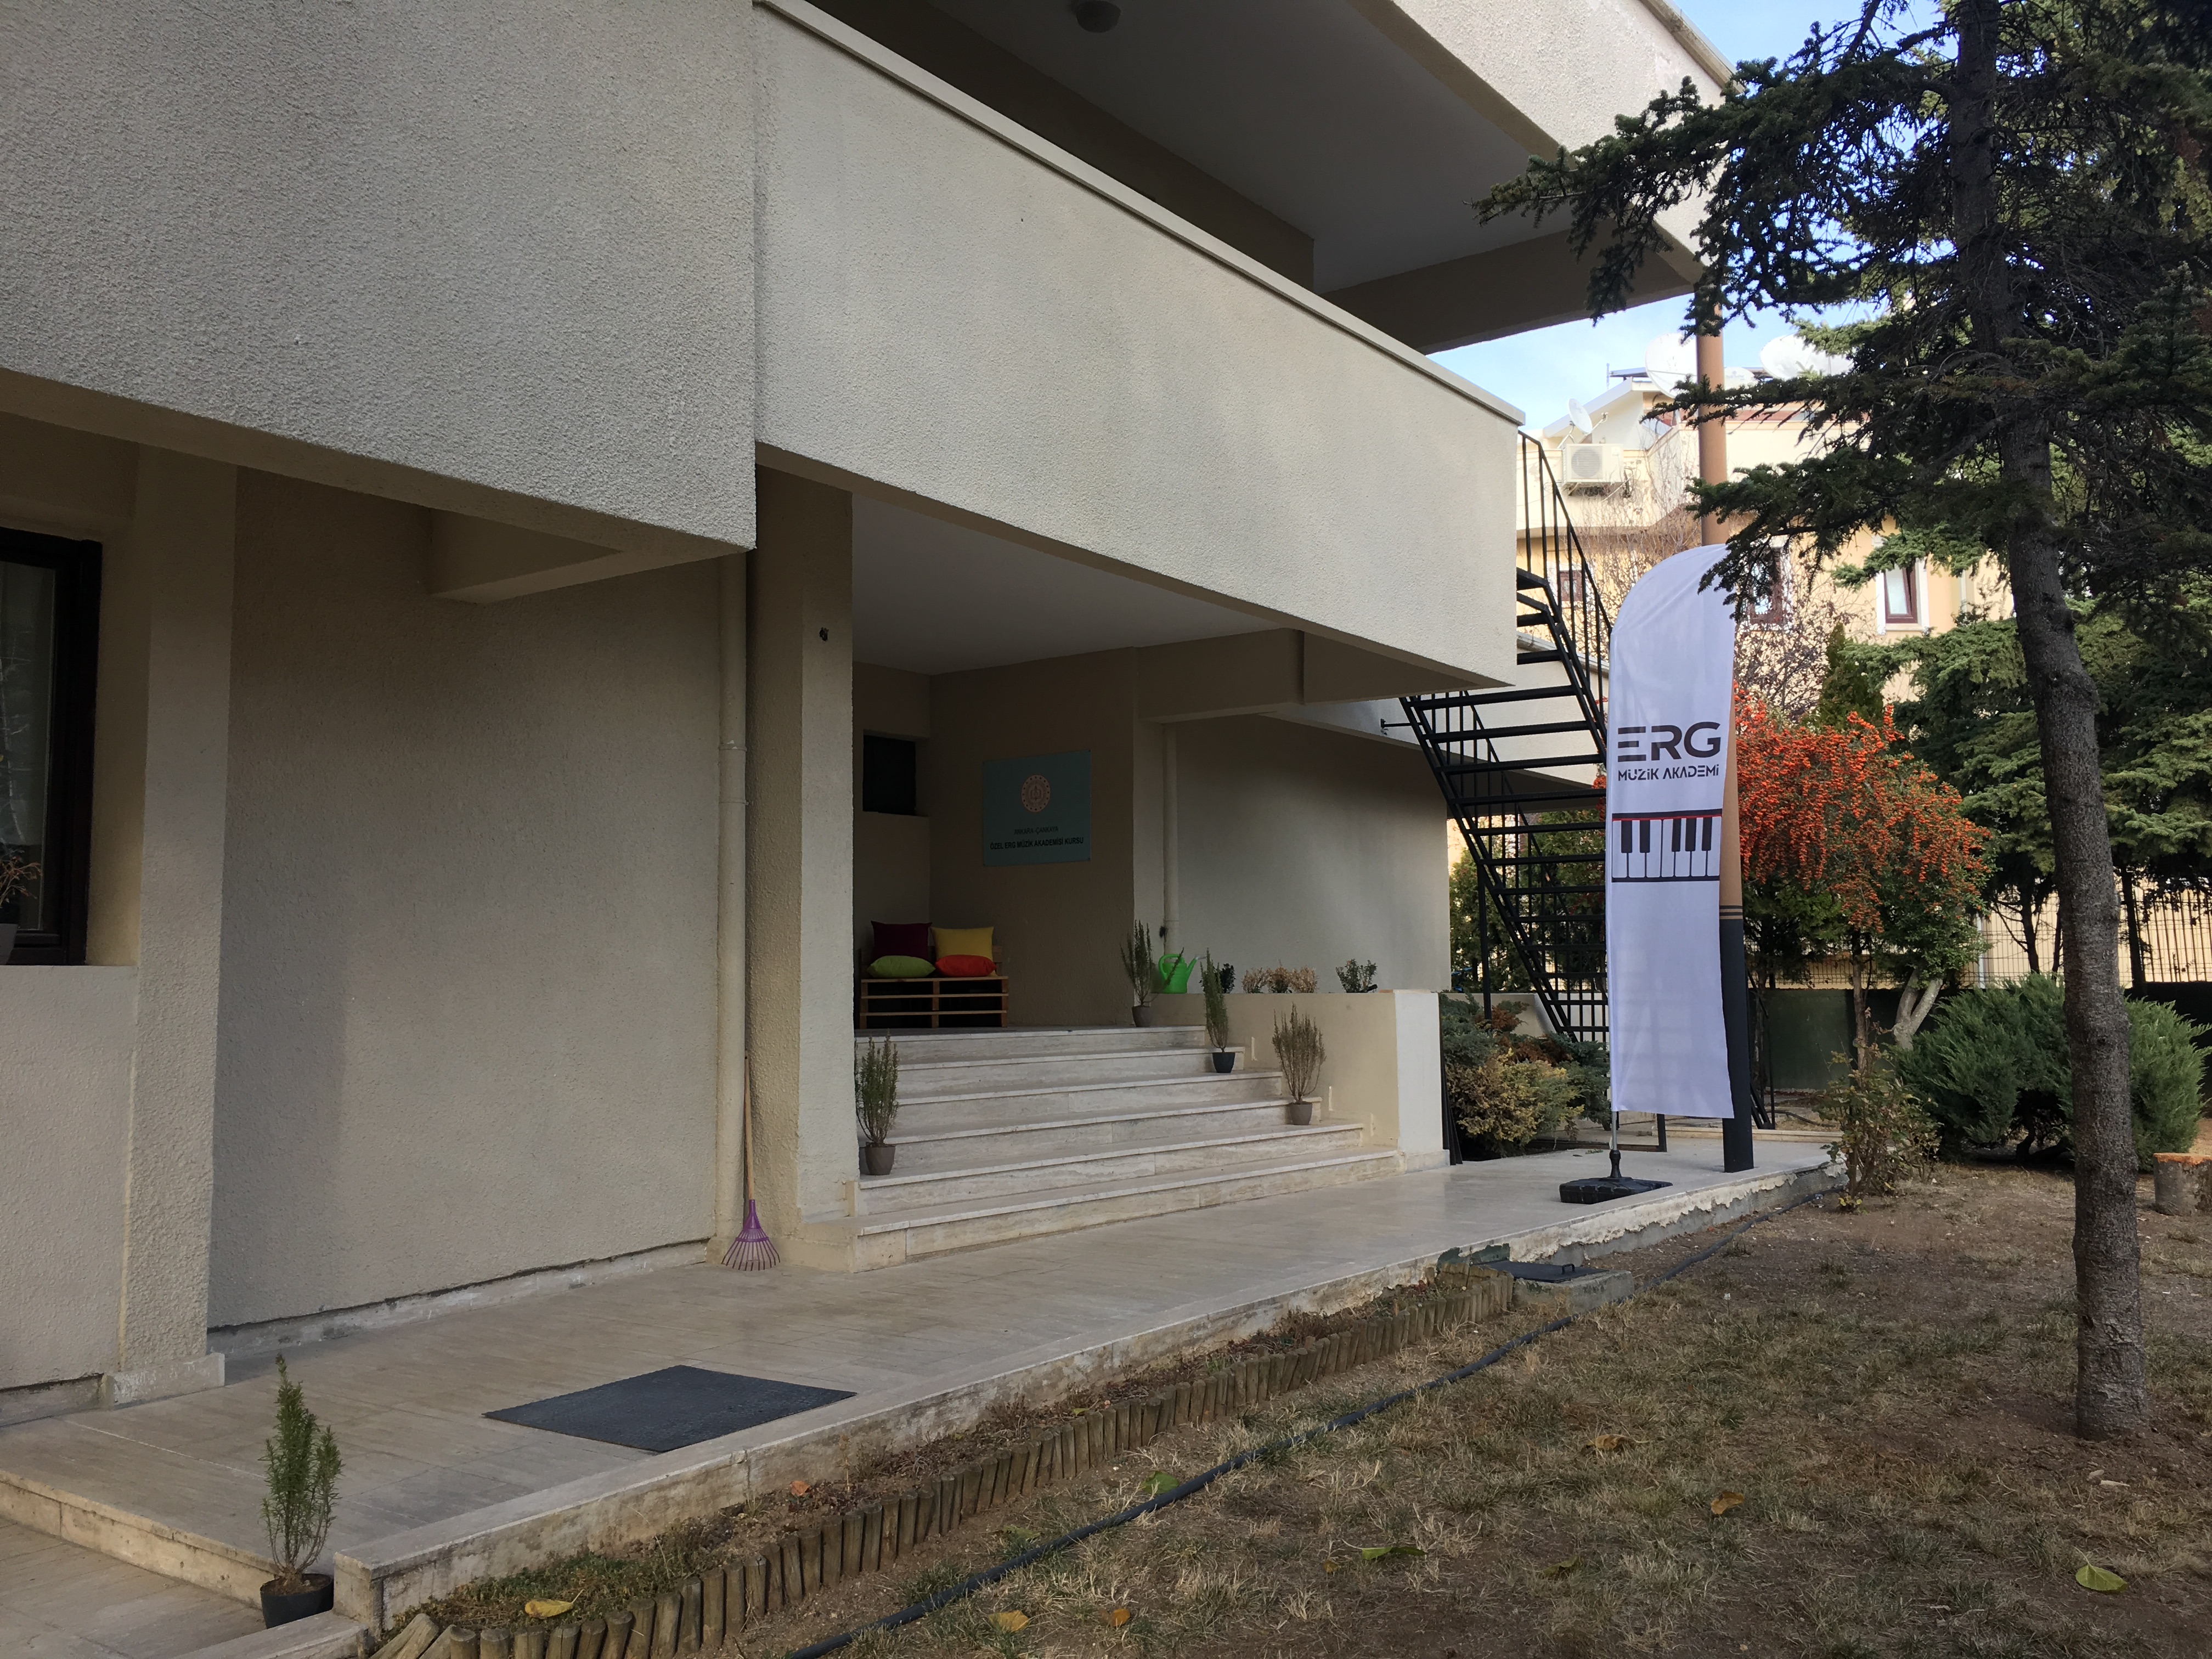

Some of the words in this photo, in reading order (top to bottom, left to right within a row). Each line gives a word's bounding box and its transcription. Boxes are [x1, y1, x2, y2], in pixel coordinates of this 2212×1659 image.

[1617, 721, 1721, 763] ERG
[990, 842, 1003, 850] ÖZEL
[1017, 839, 1034, 848] MÜZİK
[1034, 837, 1063, 847] AKADEMİSİ
[1064, 836, 1084, 845] KURSU
